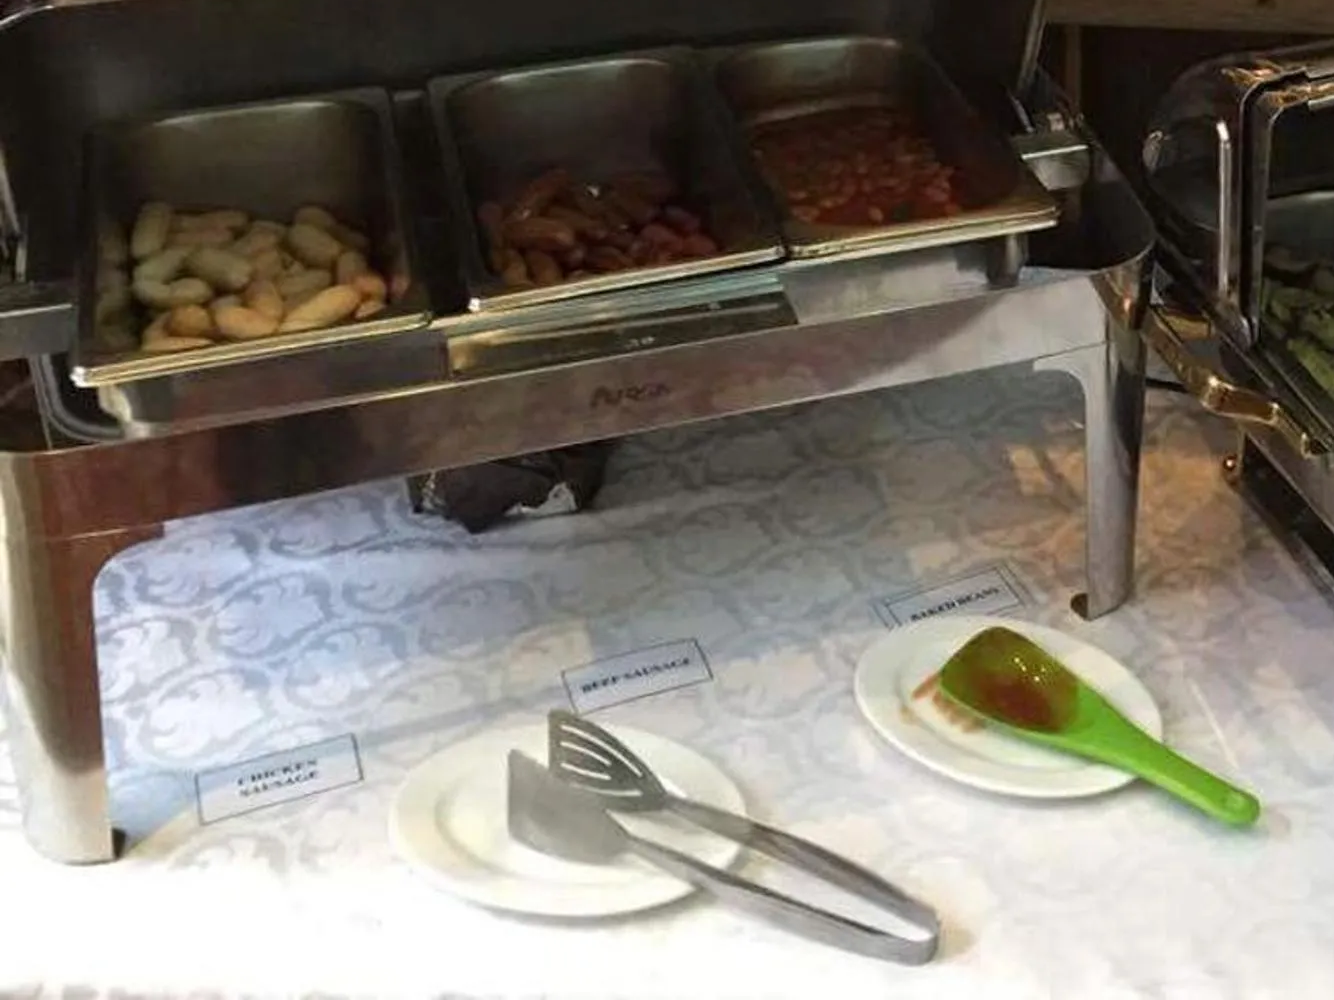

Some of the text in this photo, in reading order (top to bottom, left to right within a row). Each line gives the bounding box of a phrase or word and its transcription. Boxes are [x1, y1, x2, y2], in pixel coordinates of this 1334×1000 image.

[582, 657, 690, 693] BEEF SAUSAGE
[237, 759, 318, 785] CHICKEN
[239, 771, 318, 798] SAUSAGE
